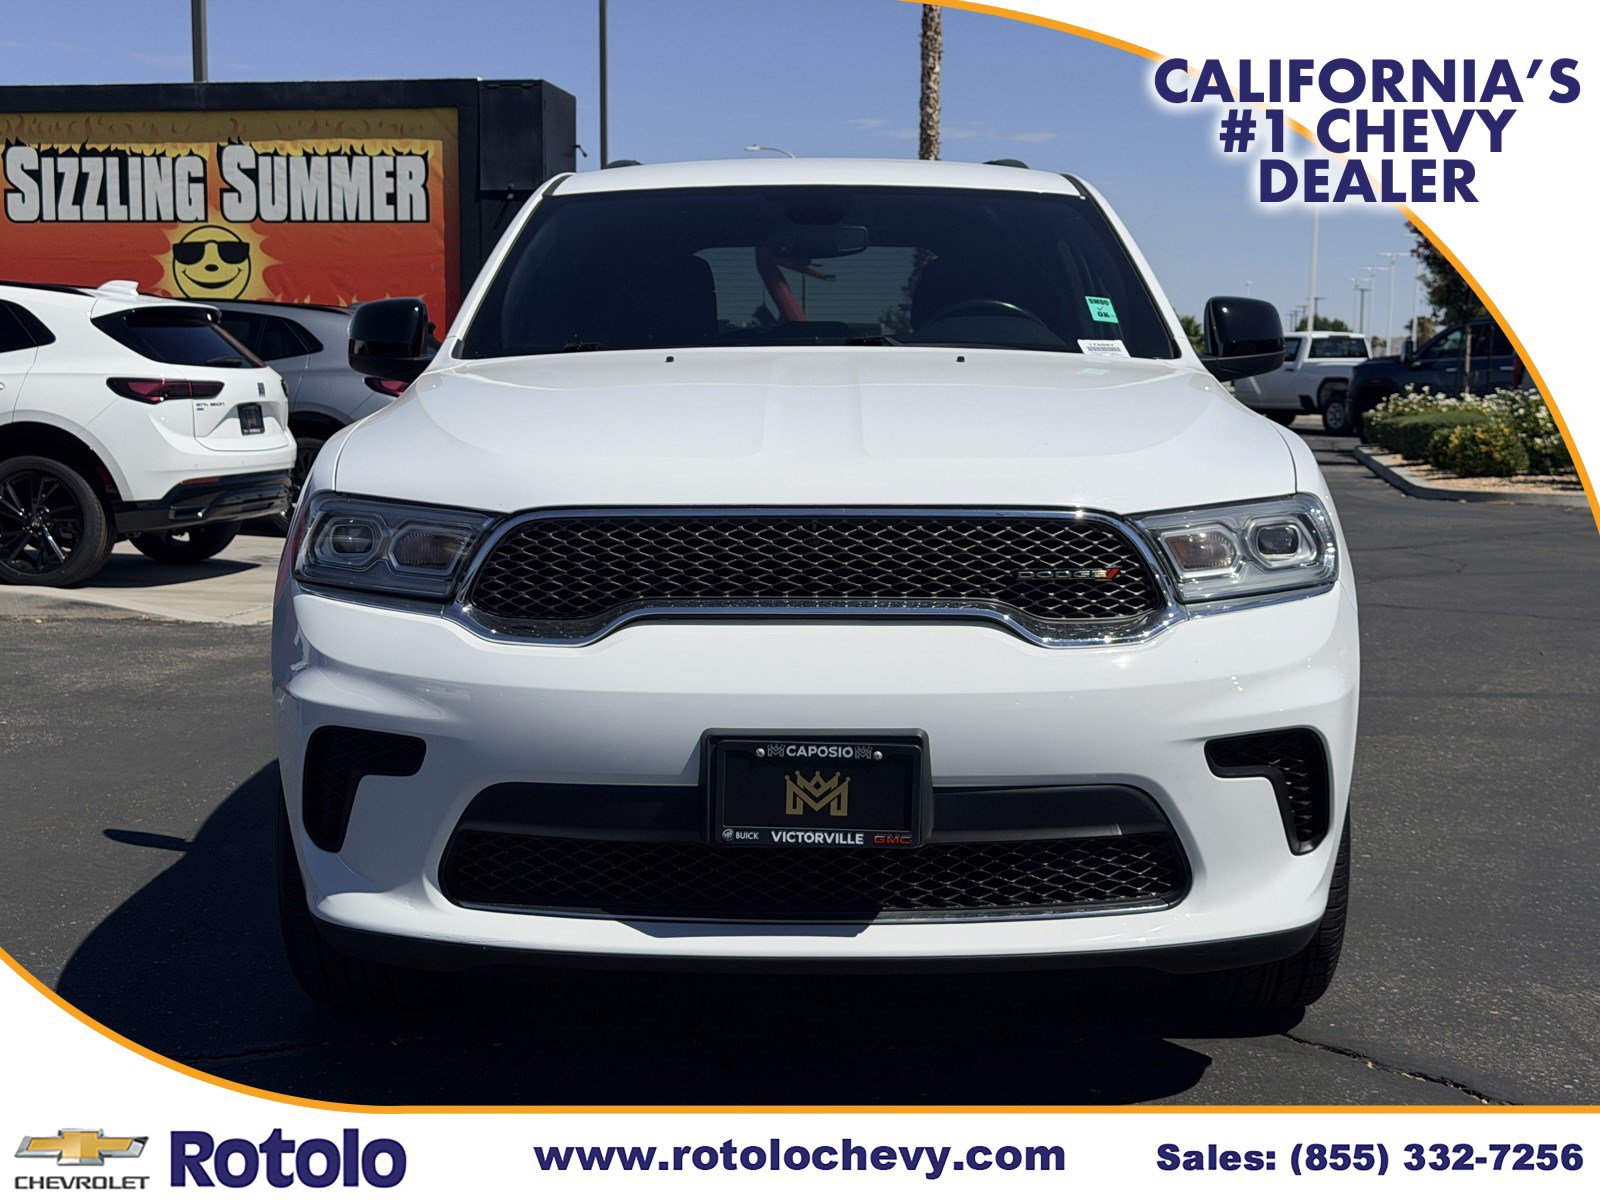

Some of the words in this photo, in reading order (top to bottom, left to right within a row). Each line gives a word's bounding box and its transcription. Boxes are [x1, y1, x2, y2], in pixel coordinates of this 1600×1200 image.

[5, 144, 208, 223] SIZZLING
[220, 143, 429, 223] SUMMER
[1017, 569, 1107, 579] DODGE
[786, 744, 854, 759] CAPOSIO
[735, 830, 759, 840] BUICK
[771, 830, 864, 845] VICTORVILLE
[873, 834, 912, 845] GMC
